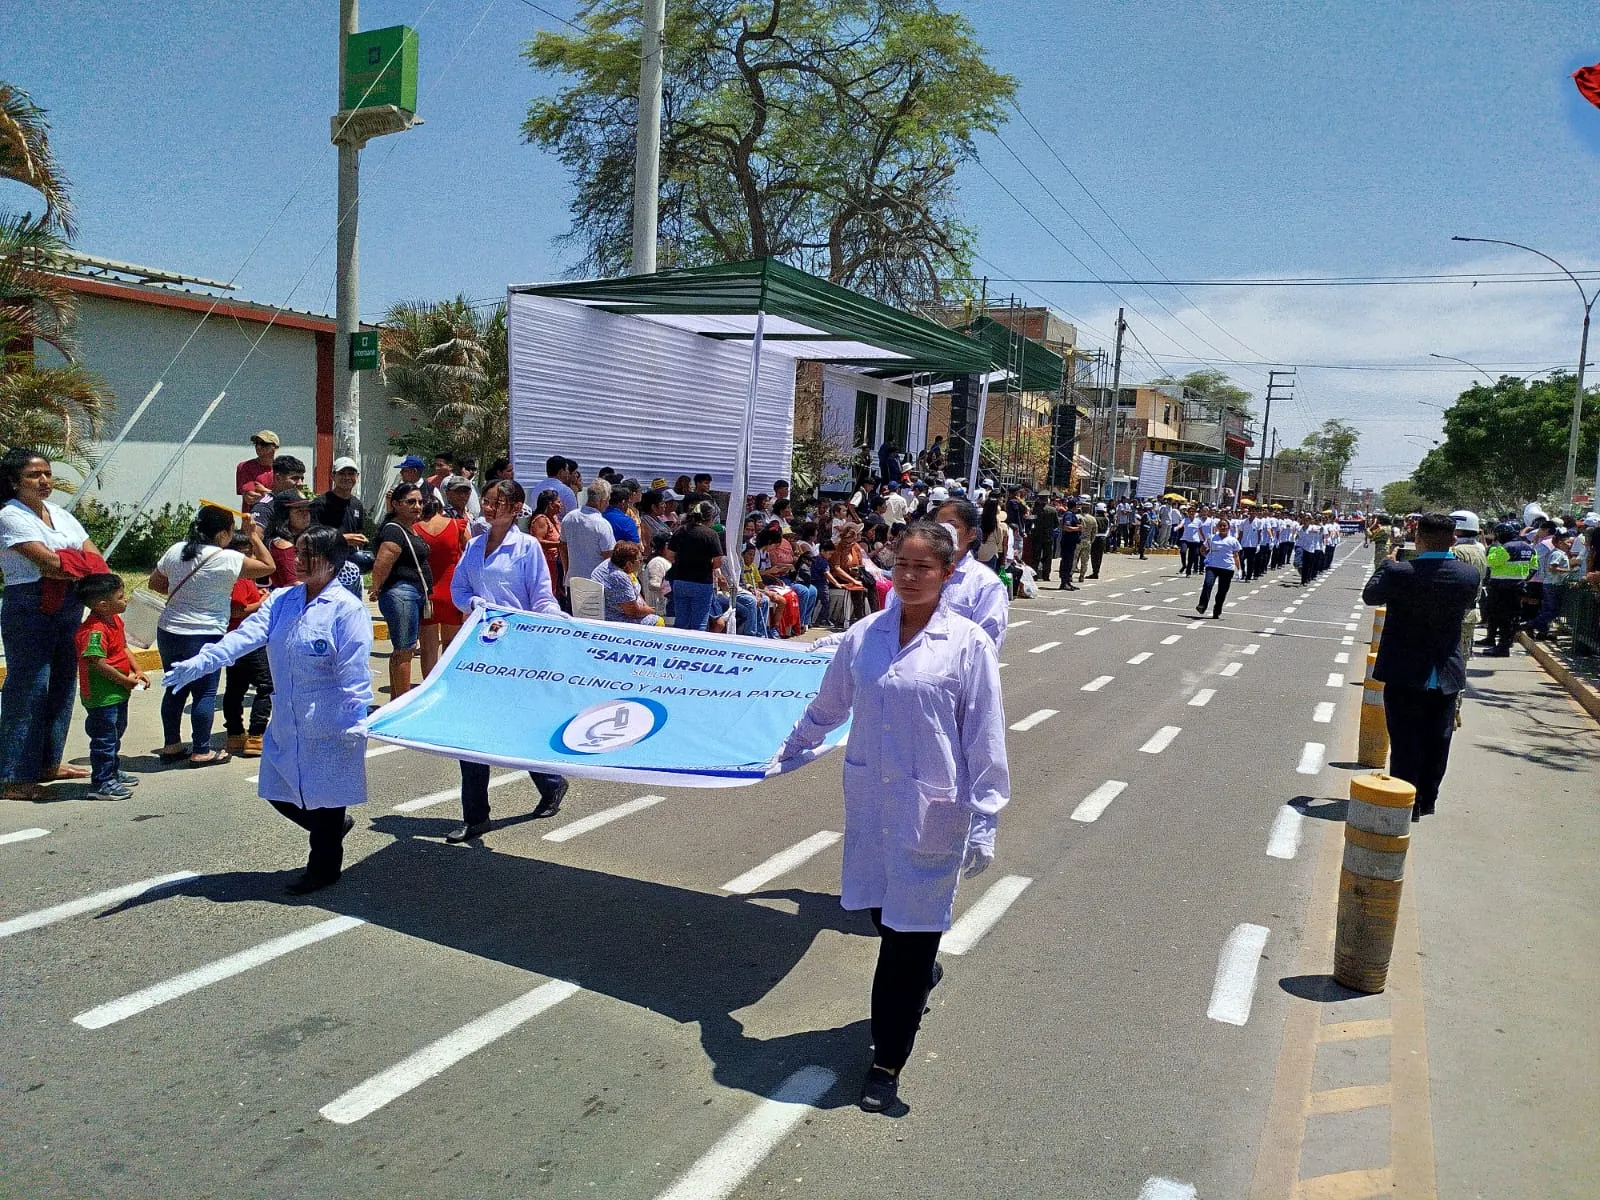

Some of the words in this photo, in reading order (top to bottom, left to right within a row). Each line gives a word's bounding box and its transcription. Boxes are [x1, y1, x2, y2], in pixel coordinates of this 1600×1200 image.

[515, 623, 571, 636] INSTITUTO
[572, 630, 590, 639] DE
[591, 633, 663, 650] EDUCACIÓN
[665, 643, 727, 658] SUPERIOR
[730, 651, 822, 665] TECNOLÓGICO
[455, 660, 565, 682] LABORATORIO
[568, 675, 633, 691] CLÍNICO
[638, 683, 650, 693] Y
[651, 685, 741, 698] ANATOMIA
[631, 669, 684, 681] SULLANA
